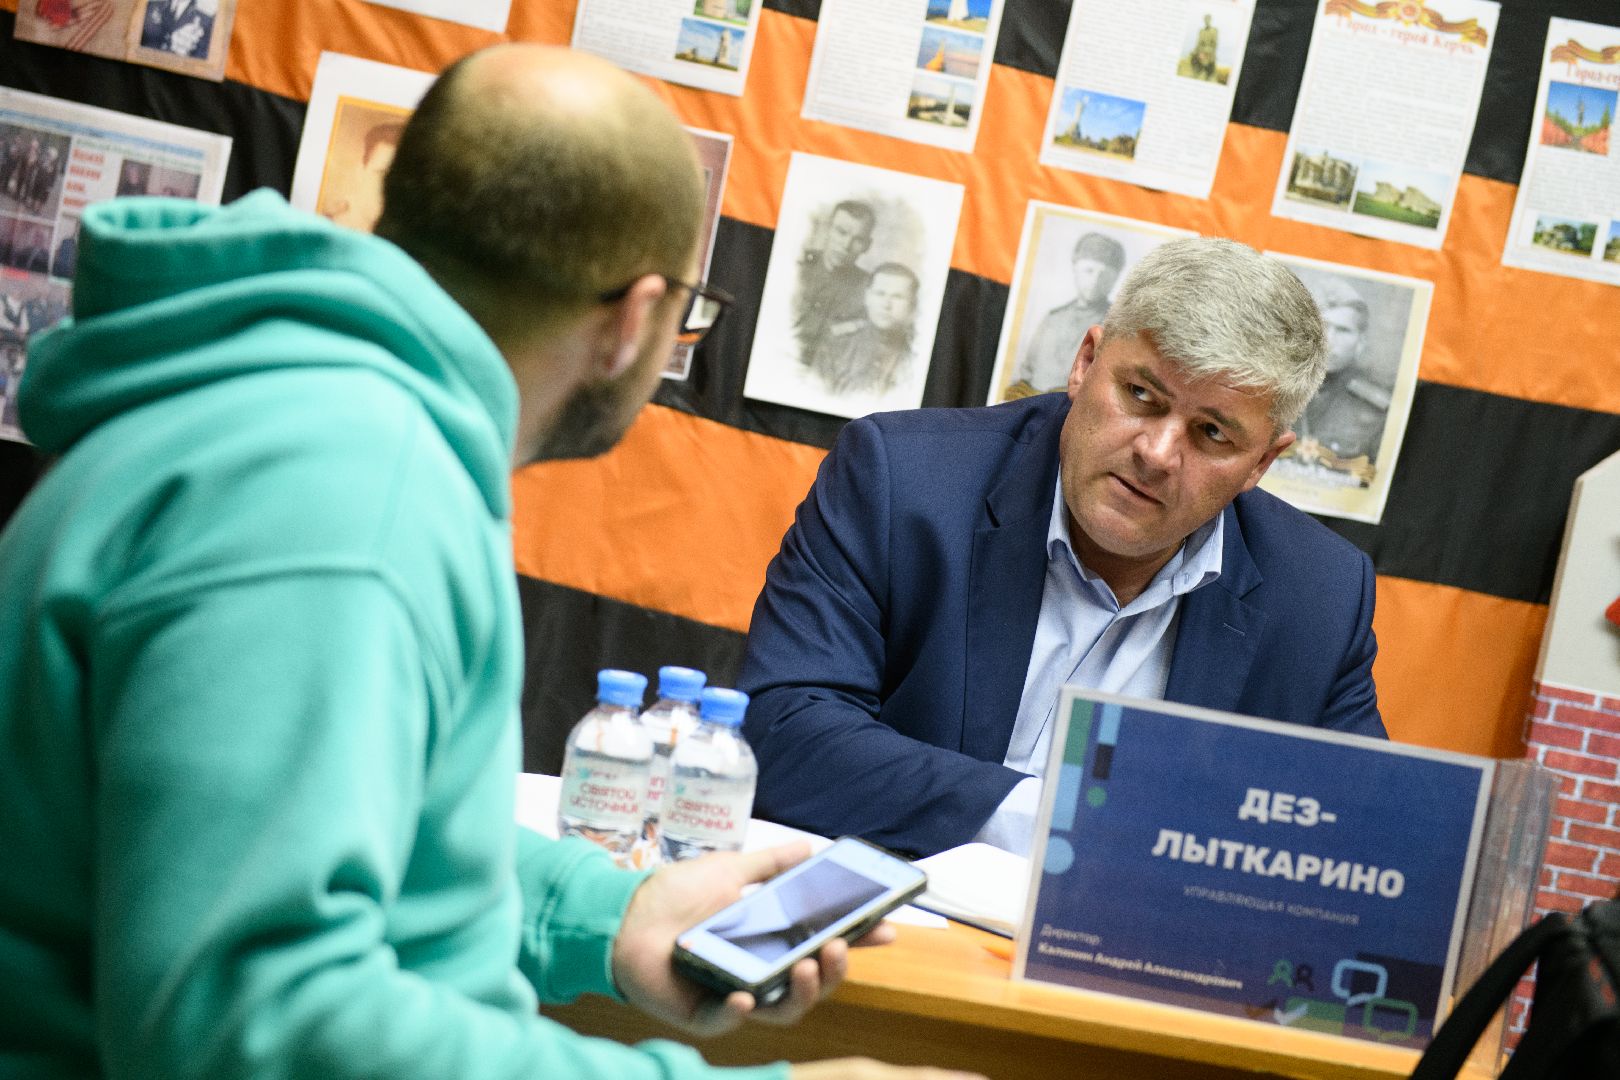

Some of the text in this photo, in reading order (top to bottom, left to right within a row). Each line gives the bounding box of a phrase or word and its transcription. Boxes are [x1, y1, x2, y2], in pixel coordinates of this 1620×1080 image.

[1237, 786, 1338, 828] ДЕЗ-
[1151, 828, 1406, 899] ЛЫТКАРИНО
[1183, 885, 1360, 926] УПРАВЛЯЮЩАЯ КОМПАНИЯ
[1094, 952, 1144, 972] Андрей
[1143, 961, 1244, 990] Александрович
